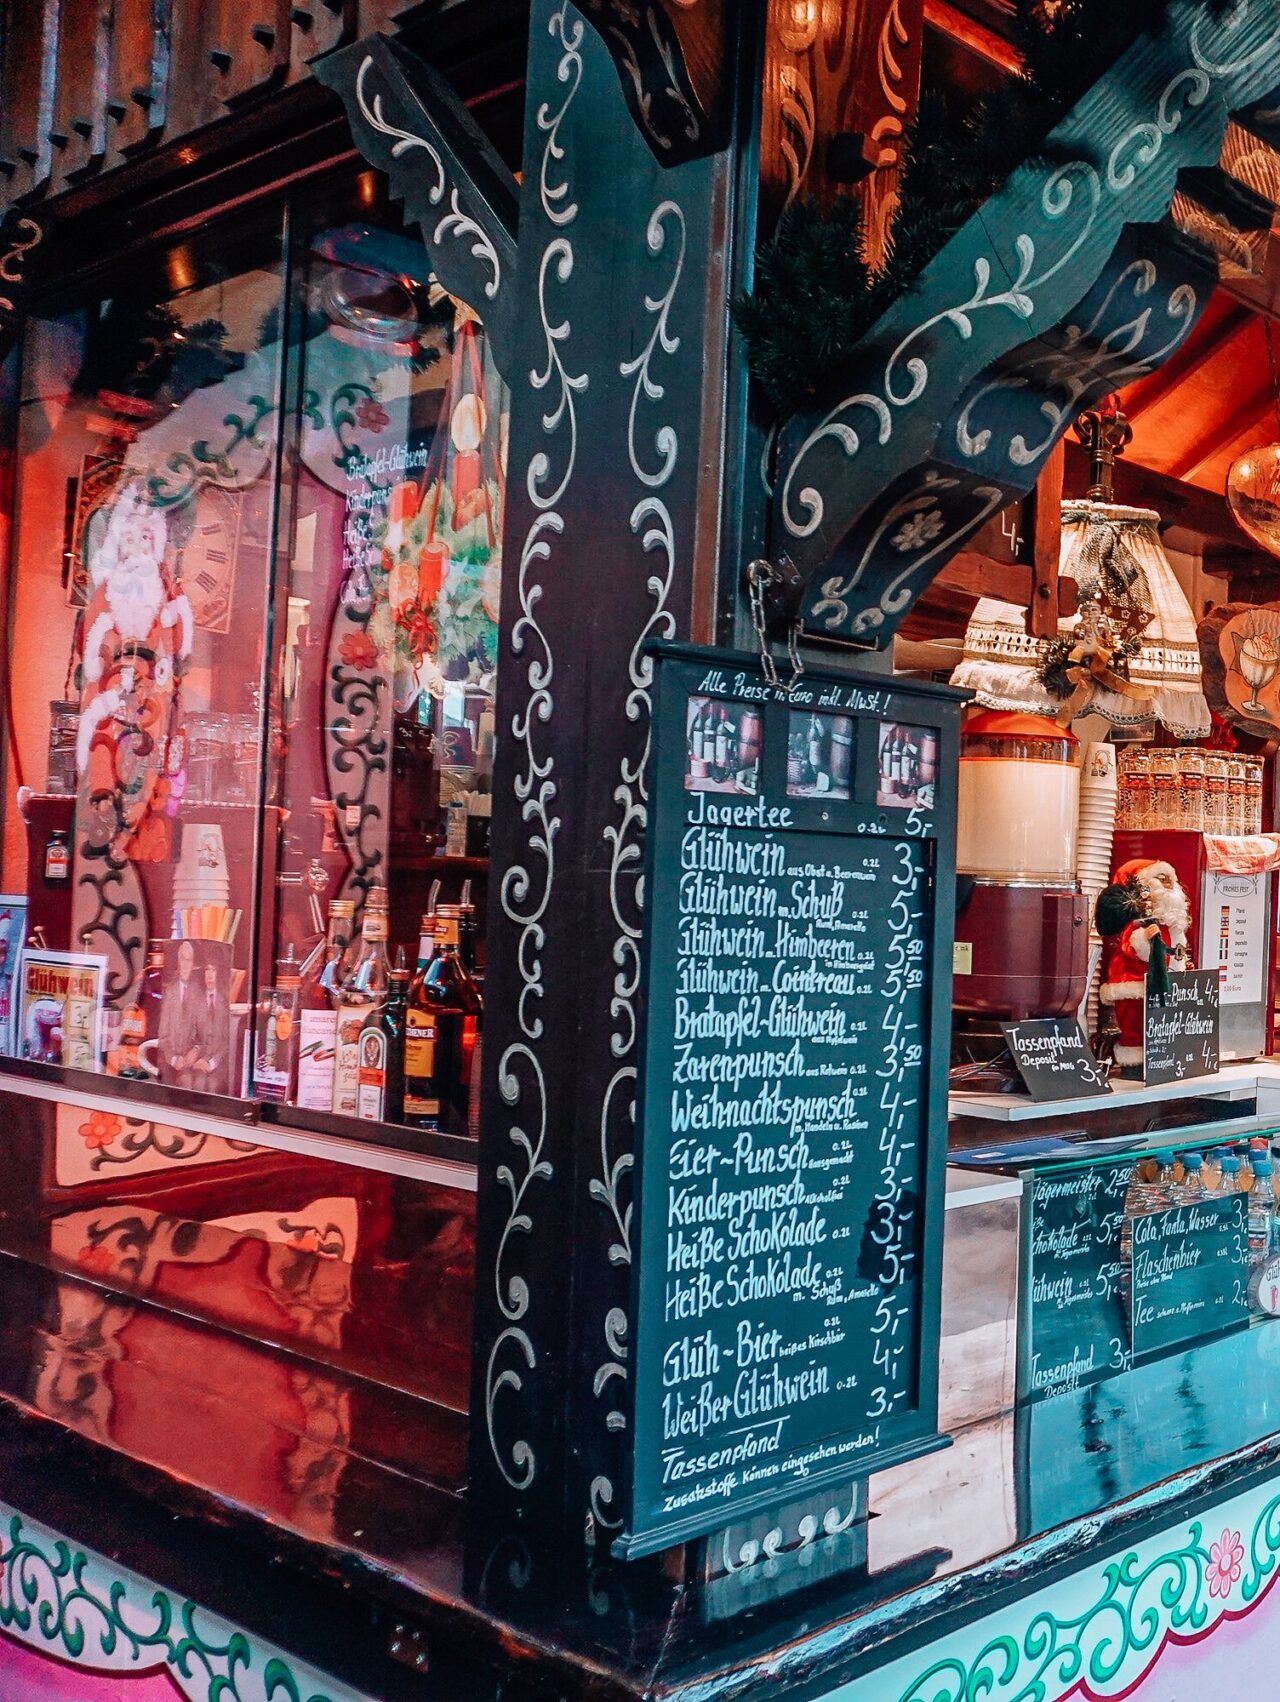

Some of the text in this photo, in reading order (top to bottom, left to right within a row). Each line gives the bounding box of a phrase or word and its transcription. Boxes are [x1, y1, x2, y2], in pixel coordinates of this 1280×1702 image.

[698, 670, 727, 694] Alle
[732, 671, 772, 701] Preise
[681, 826, 785, 877] Glühwein
[679, 871, 777, 918] Glühwein
[791, 879, 845, 920] Schuß
[676, 916, 765, 959] Glühwein
[774, 919, 856, 961] Himbeeren
[675, 957, 759, 995] Glühwein
[772, 959, 856, 995] Cointreau
[1006, 1024, 1085, 1057] Tassenpfand
[1020, 1051, 1058, 1071] Deposit
[672, 1039, 806, 1093] Zarenpunsch
[670, 1078, 858, 1139] Weihnachtspunsch
[668, 1168, 805, 1228] Kinderpunsch
[1188, 1207, 1219, 1232] Wasser
[666, 1216, 725, 1273] Heiße
[1135, 1239, 1201, 1281] Flaschenbier
[665, 1267, 724, 1323] Heiße
[1135, 1294, 1154, 1327] Tee
[1032, 1343, 1094, 1389] Tassenpfand
[1044, 1375, 1080, 1398] Deposit
[662, 1376, 734, 1441] Weißer
[733, 1359, 830, 1421] Glühwein
[662, 1414, 792, 1484] Tassenpfand
